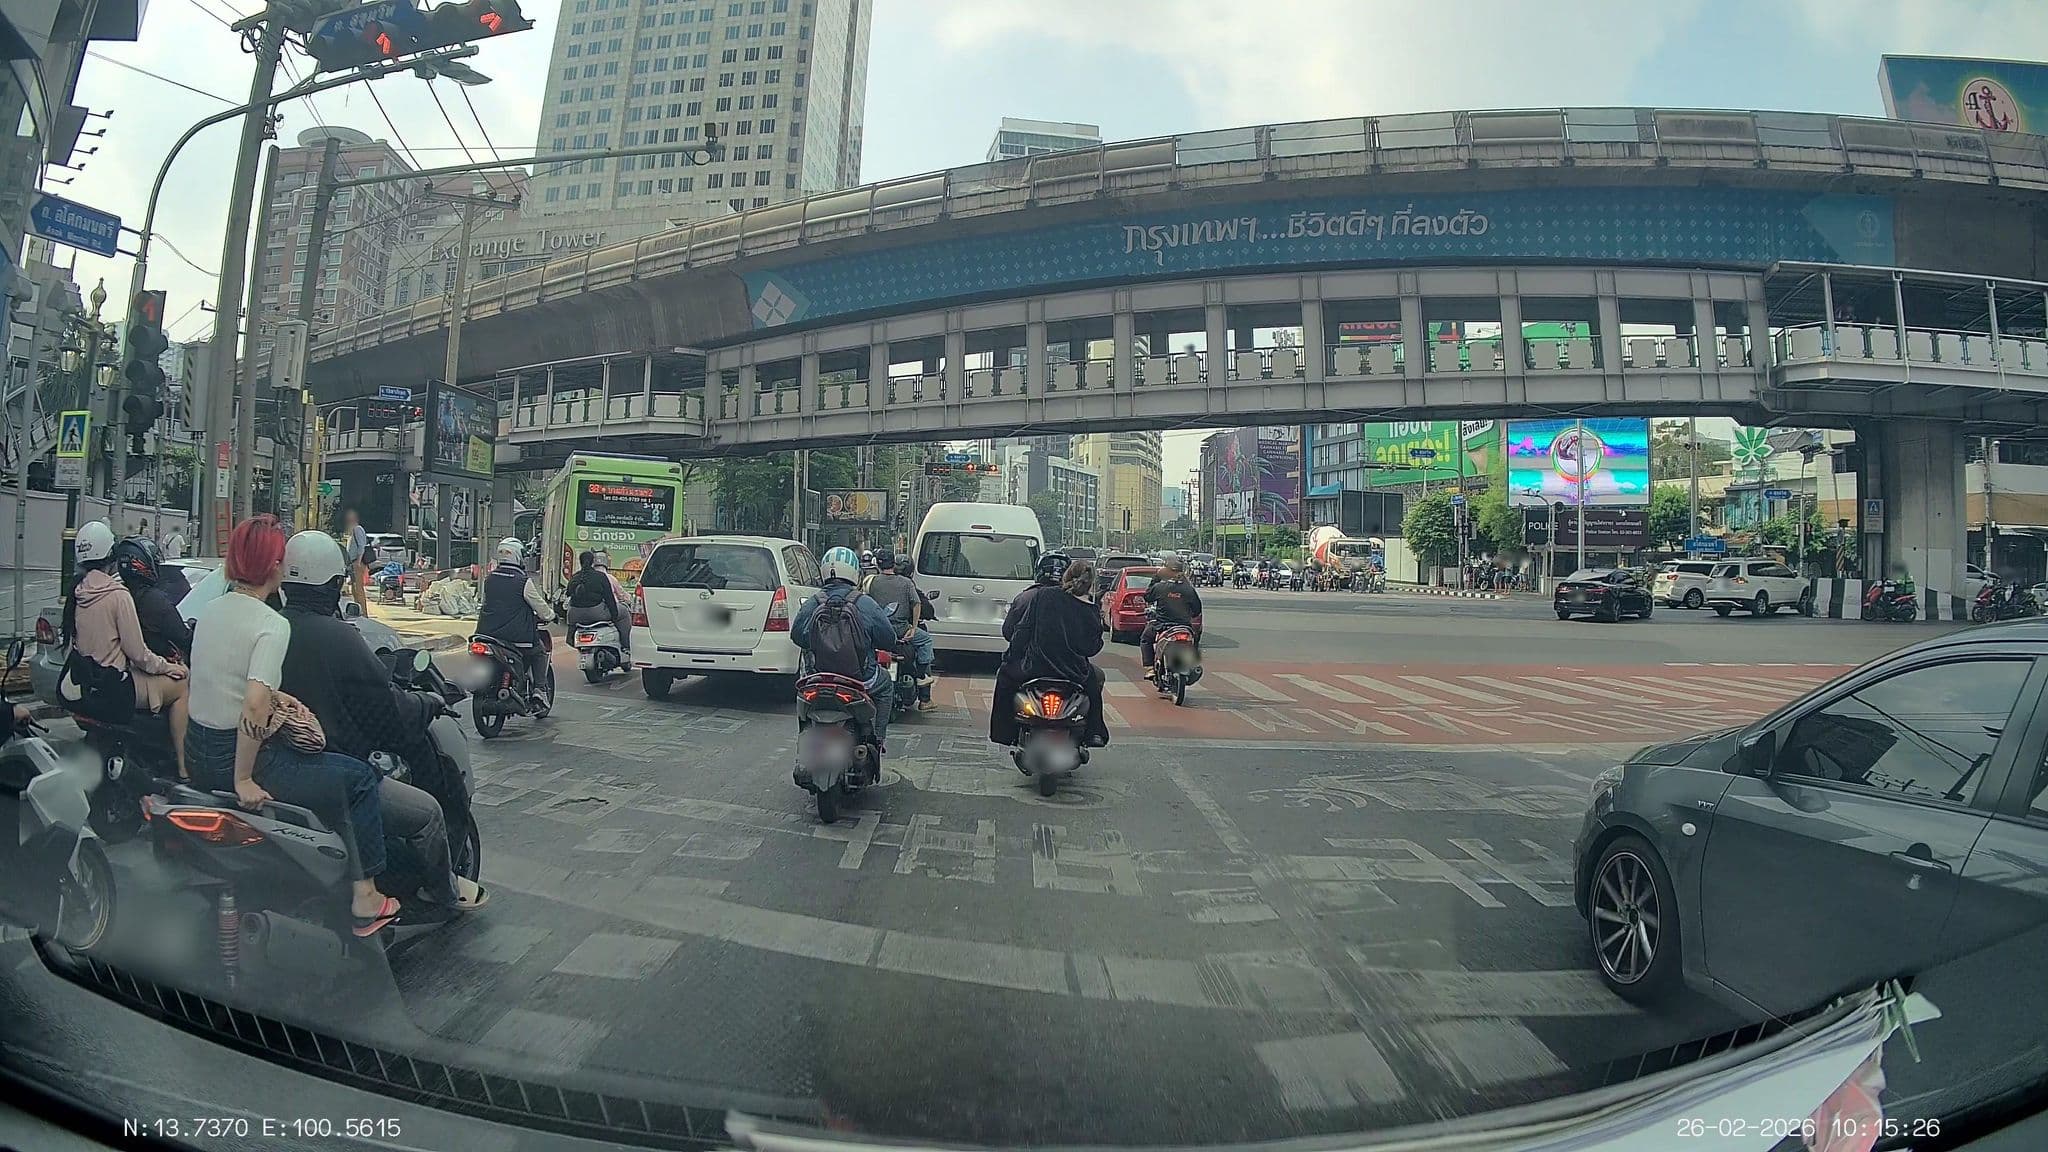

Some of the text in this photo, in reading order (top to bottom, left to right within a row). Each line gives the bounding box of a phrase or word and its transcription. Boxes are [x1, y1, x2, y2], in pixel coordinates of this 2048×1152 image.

[54, 204, 115, 239] อโศกมนตรี
[1391, 202, 1489, 236] ที่ลงตัว
[429, 229, 606, 259] Excange Tower
[593, 528, 636, 541] ฉีกซอง
[1528, 521, 1559, 531] POLIE
